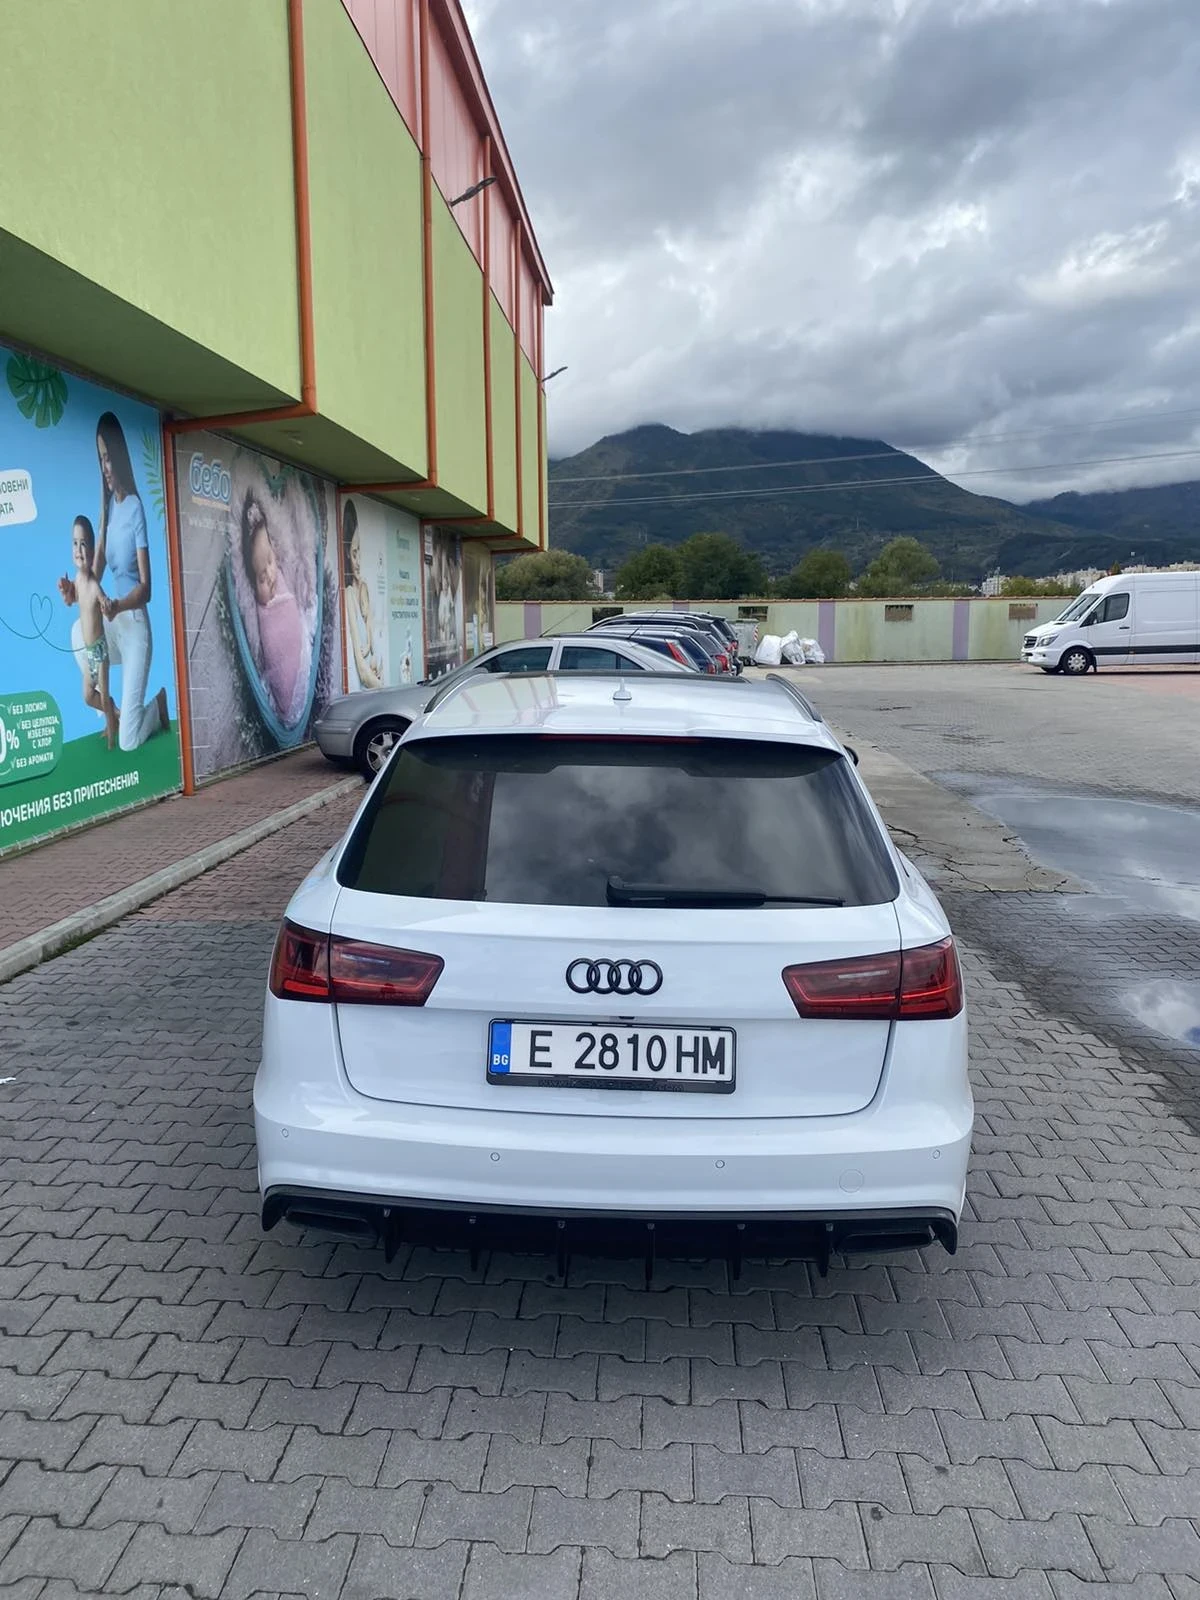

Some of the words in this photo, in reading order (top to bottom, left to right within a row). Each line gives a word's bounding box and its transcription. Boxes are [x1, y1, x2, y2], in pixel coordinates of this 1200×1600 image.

[0, 479, 29, 494] ОВЕНИ
[12, 705, 23, 715] БЕЗ
[21, 720, 32, 730] БЕЗ
[16, 758, 27, 768] БЕЗ
[52, 791, 72, 811] БЕЗ
[74, 771, 140, 804] ПРИТЕСНЕНИЯ
[529, 1030, 553, 1068] E
[493, 1054, 509, 1066] BG
